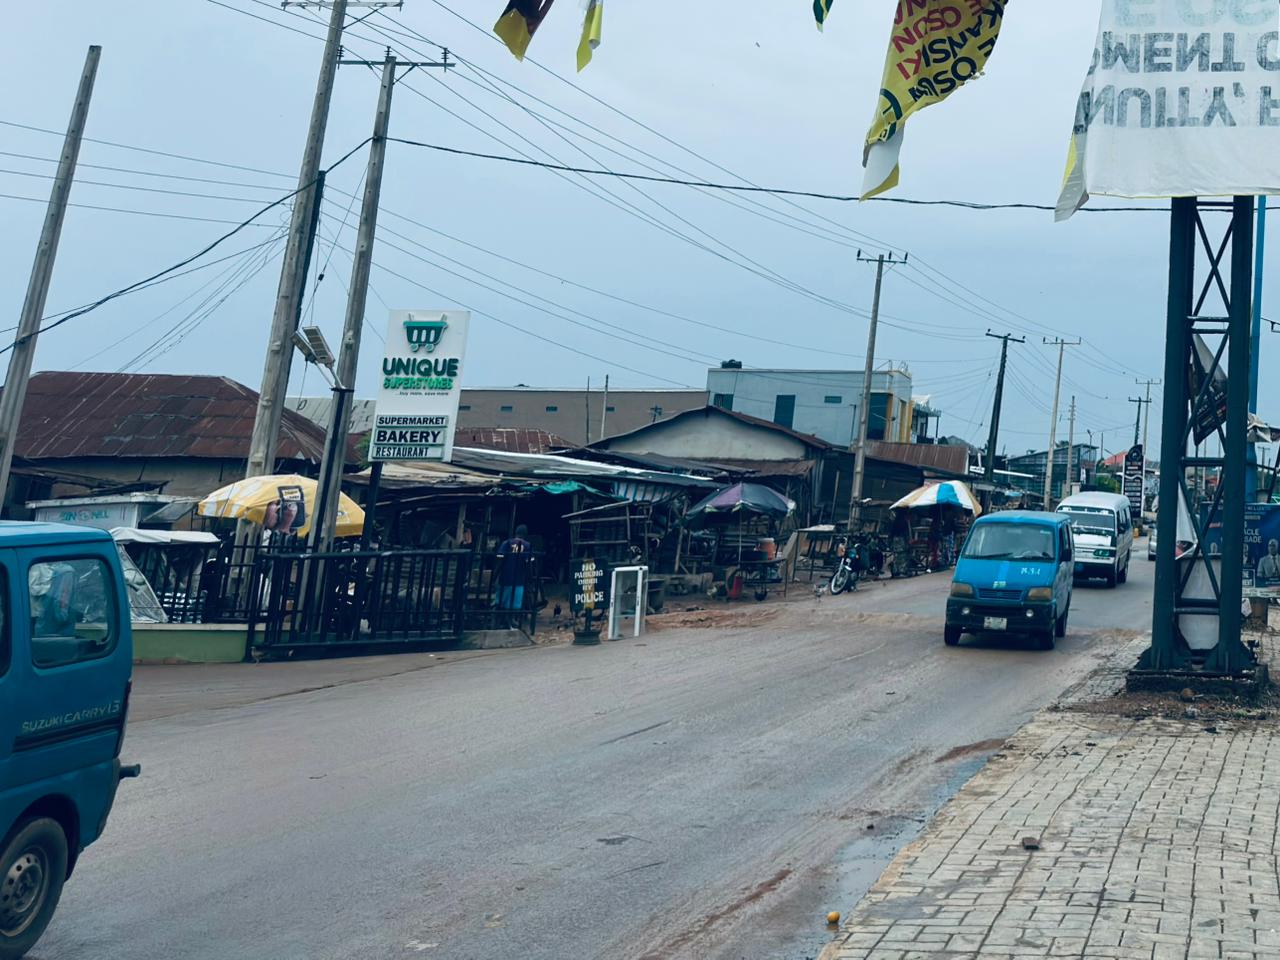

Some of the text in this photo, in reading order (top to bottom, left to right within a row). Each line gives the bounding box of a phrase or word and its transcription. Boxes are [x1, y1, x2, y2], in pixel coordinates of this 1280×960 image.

[892, 6, 962, 54] OSUN
[382, 357, 460, 377] UNIQUE
[383, 377, 454, 390] SUPERSTORES
[378, 416, 446, 425] SUPERMARKET
[376, 430, 441, 443] BAKERY
[375, 446, 429, 457] RESTAURANT
[582, 562, 596, 571] NO
[574, 570, 604, 579] PARKING
[575, 591, 604, 604] POLICE
[22, 715, 63, 731] SUZUKI
[63, 707, 106, 723] CARRY
